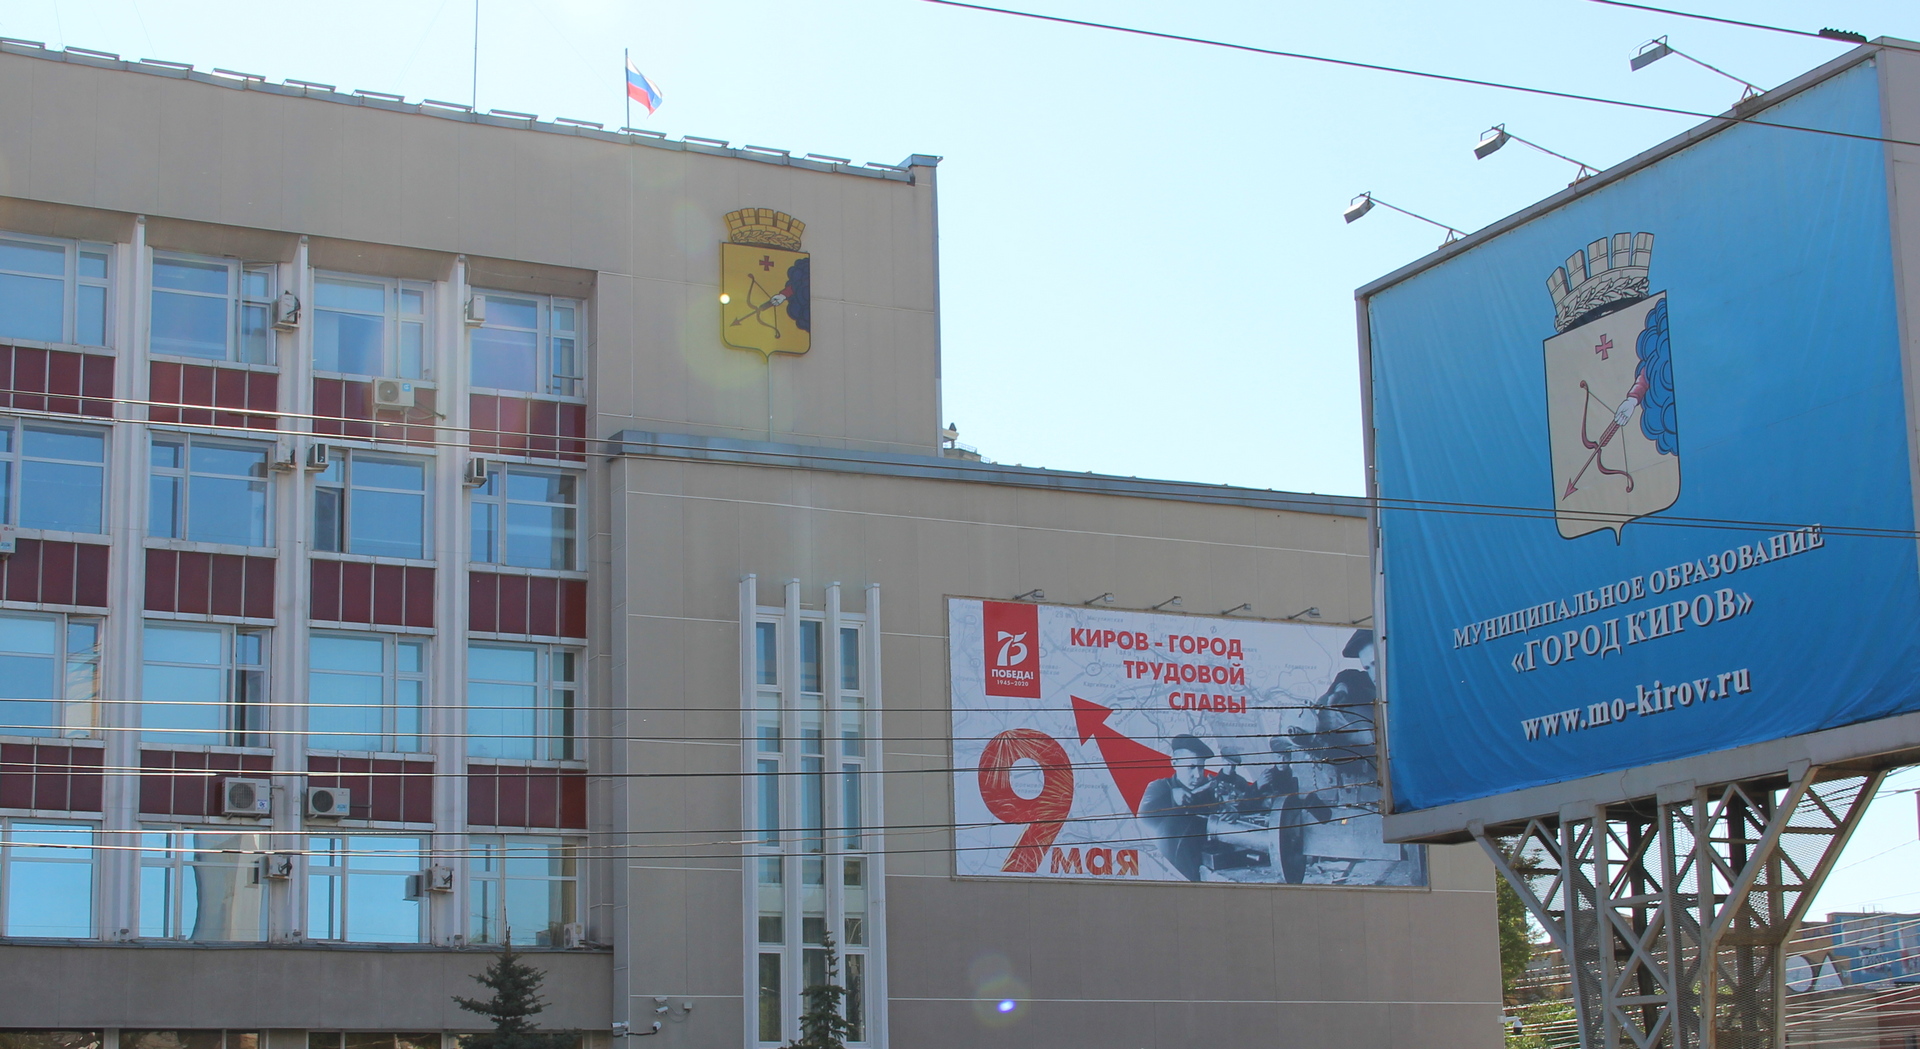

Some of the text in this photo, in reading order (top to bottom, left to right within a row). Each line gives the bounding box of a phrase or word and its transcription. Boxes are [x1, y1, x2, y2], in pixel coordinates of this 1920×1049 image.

[1453, 523, 1824, 649] МУНИЦИПАЛЬНОЕ ОБРАЗОВАНИЕ
[997, 630, 1028, 667] 75
[1071, 628, 1149, 651] КИРОВ
[1169, 634, 1244, 661] ГОРОД
[1511, 587, 1754, 673] «ГОРОД КИРОВ»
[991, 669, 1034, 680] ПОБЕДА!
[1123, 660, 1245, 686] ТРУДОВОЙ
[1168, 691, 1247, 715] СЛАВЫ
[1521, 667, 1751, 741] www.mo-kirov.ru
[978, 728, 1139, 876] 9 мая
